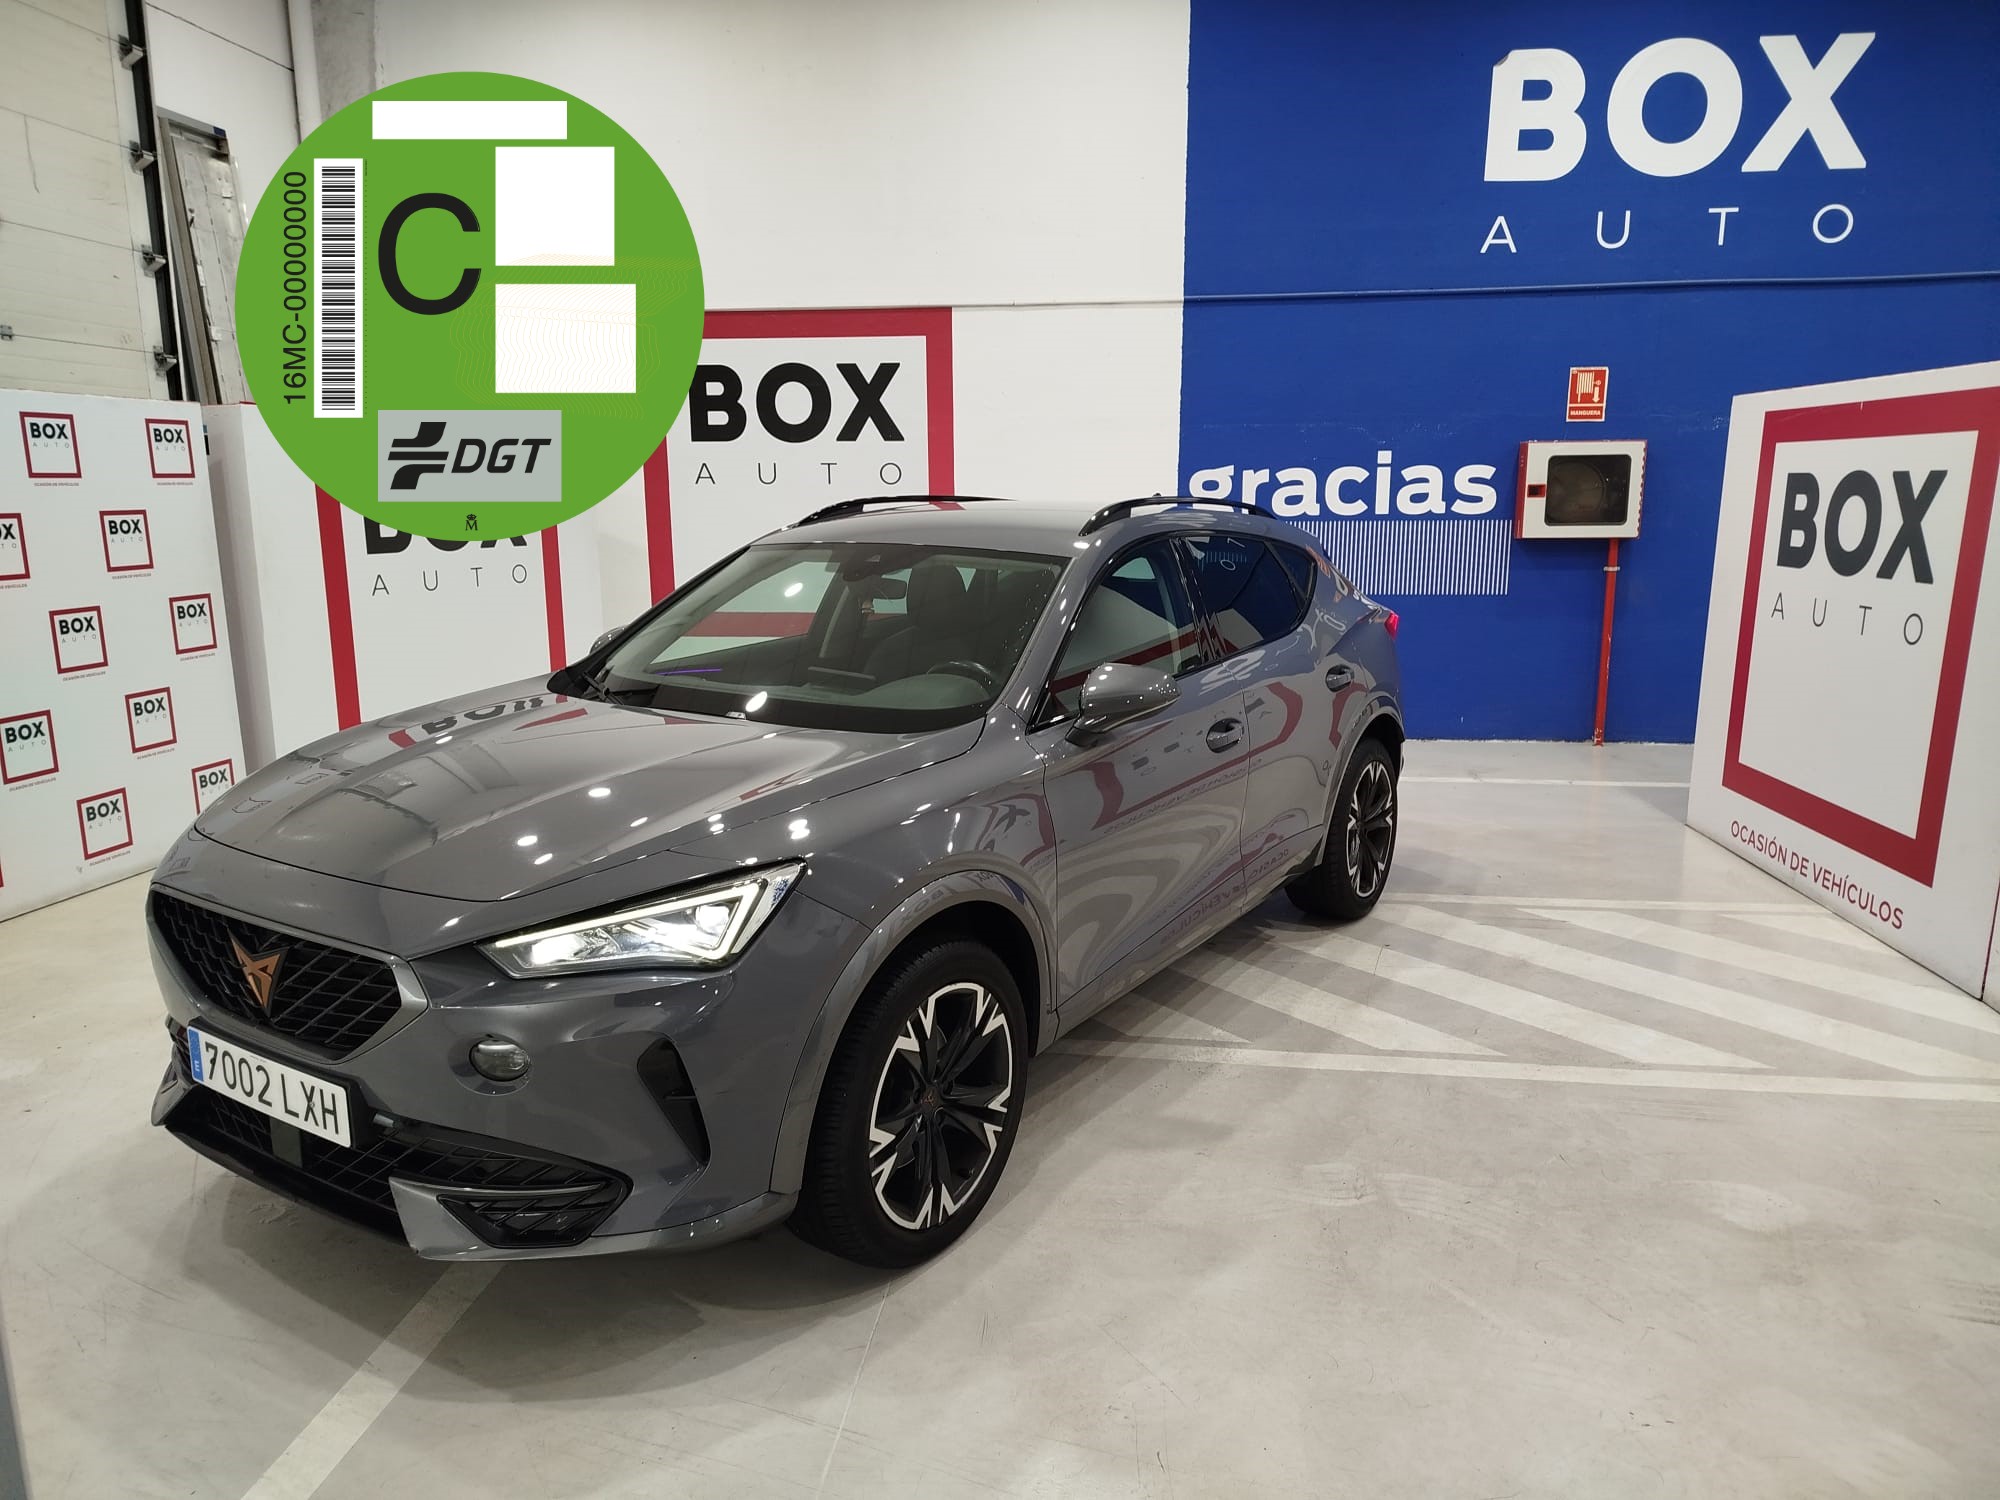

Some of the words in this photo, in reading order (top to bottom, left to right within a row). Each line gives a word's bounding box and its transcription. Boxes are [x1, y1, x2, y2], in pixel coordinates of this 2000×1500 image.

[1484, 32, 1876, 182] BOX
[1480, 203, 1853, 254] AUTO
[688, 362, 905, 443] BOX
[29, 422, 69, 440] BOX
[153, 428, 185, 444] BOX
[695, 462, 903, 485] AUTO
[1189, 450, 1498, 517] gracias
[108, 518, 142, 535] BOX
[1776, 469, 1949, 585] BOX
[372, 564, 528, 596] AUTO
[176, 602, 207, 620] BOX
[1771, 591, 1924, 646] AUTO
[58, 616, 96, 635] BOX
[133, 697, 166, 717] BOX
[4, 721, 46, 744] BOX
[199, 768, 228, 789] BOX
[85, 799, 121, 822] BOX
[1731, 820, 1787, 865] OCASIÓN
[1790, 852, 1809, 877] DE
[1812, 863, 1904, 930] VEHÍCULOS
[205, 1041, 272, 1108] 7002
[281, 1073, 339, 1135] LXH
